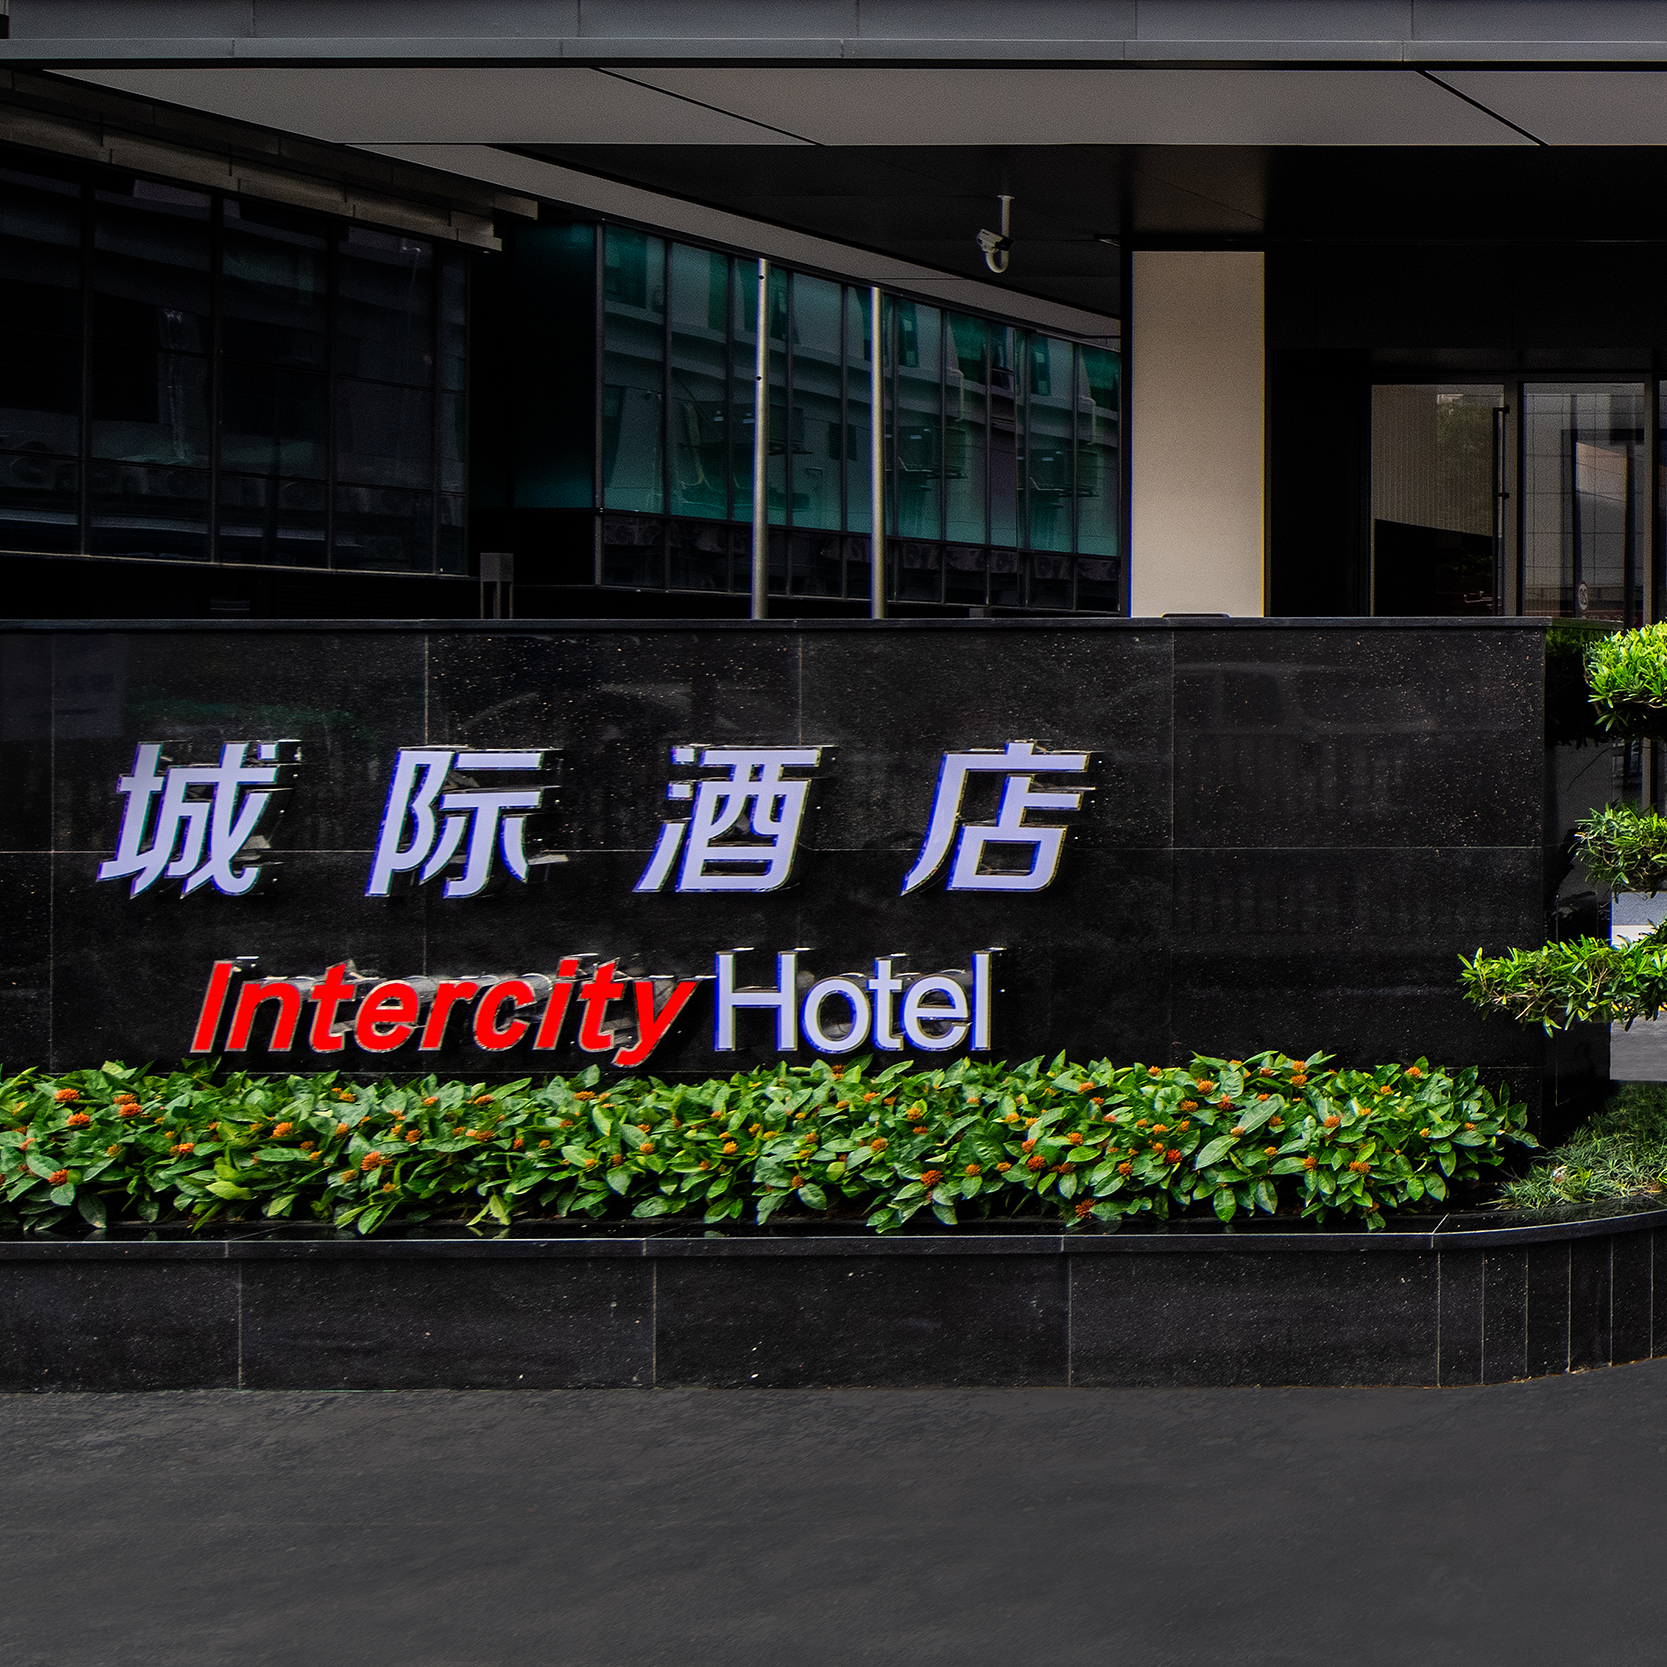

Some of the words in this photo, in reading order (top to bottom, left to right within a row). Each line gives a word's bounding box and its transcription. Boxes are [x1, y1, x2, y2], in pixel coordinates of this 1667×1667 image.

[97, 739, 1095, 898] 城际酒店
[190, 954, 704, 1067] Intercity
[713, 948, 994, 1054] Hotel
